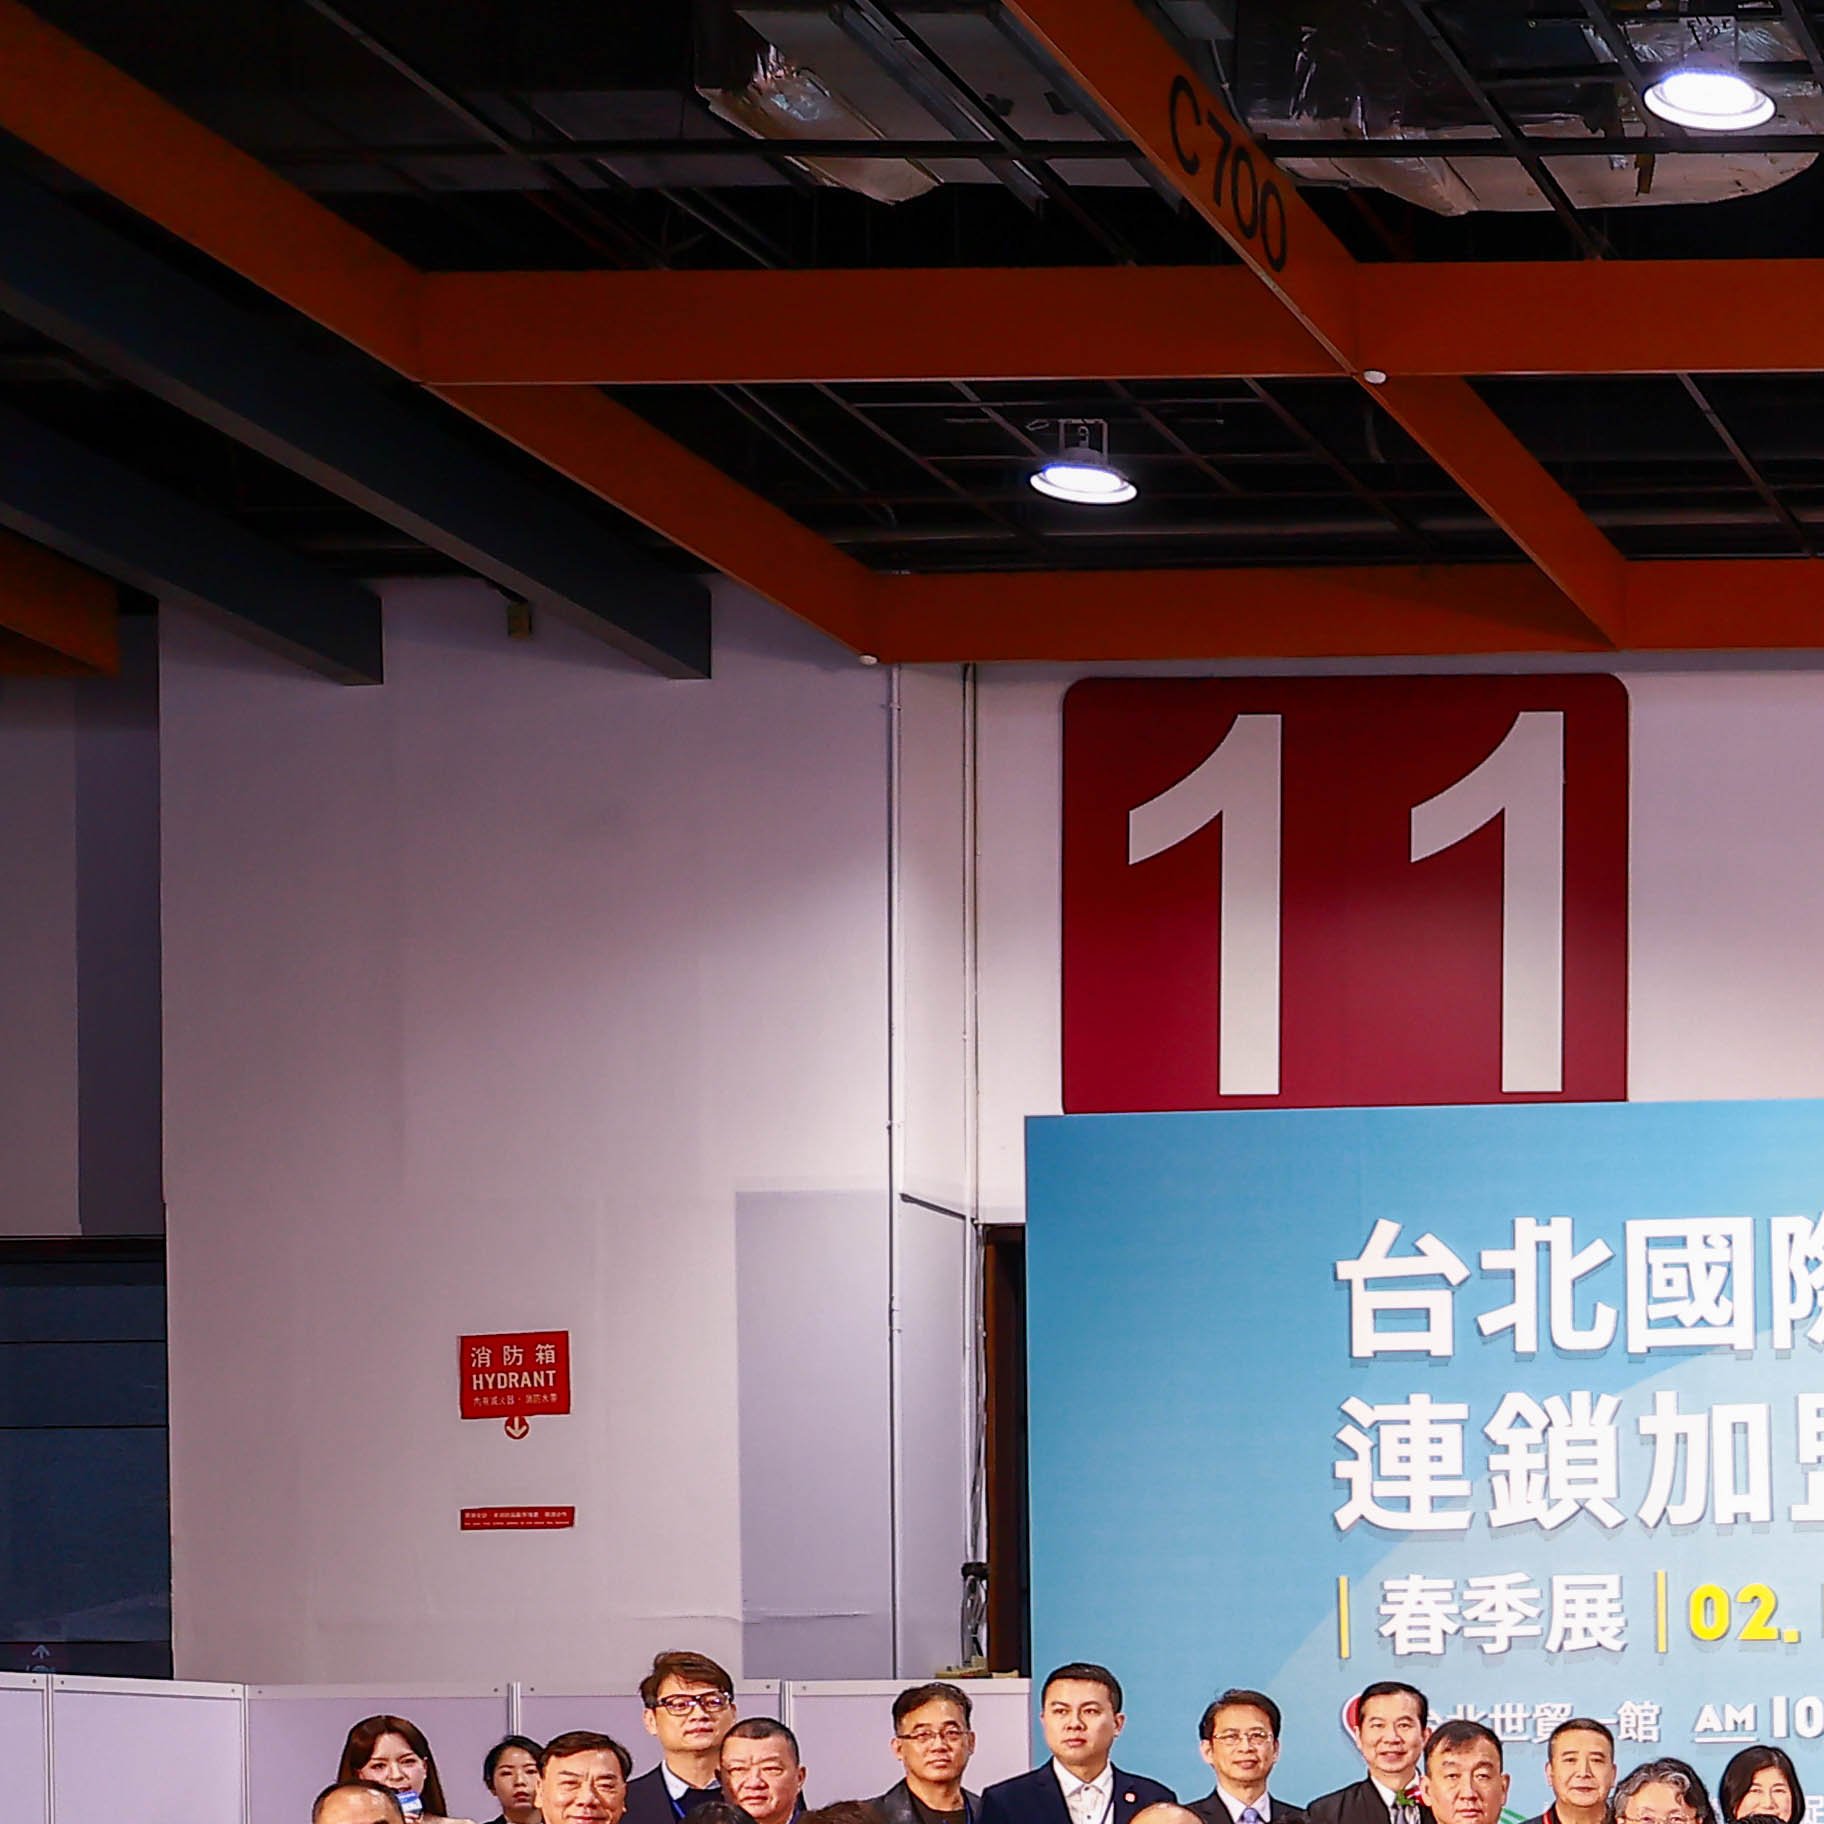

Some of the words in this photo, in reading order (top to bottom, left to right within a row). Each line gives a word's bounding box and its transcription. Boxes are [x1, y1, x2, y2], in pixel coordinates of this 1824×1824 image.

[1168, 74, 1287, 272] C700
[1128, 710, 1565, 1096] 11
[470, 1343, 556, 1368] 消防箱
[472, 1370, 556, 1390] HYDRANT
[1380, 1572, 1628, 1656] 春季展
[1695, 1703, 1757, 1733] AM
